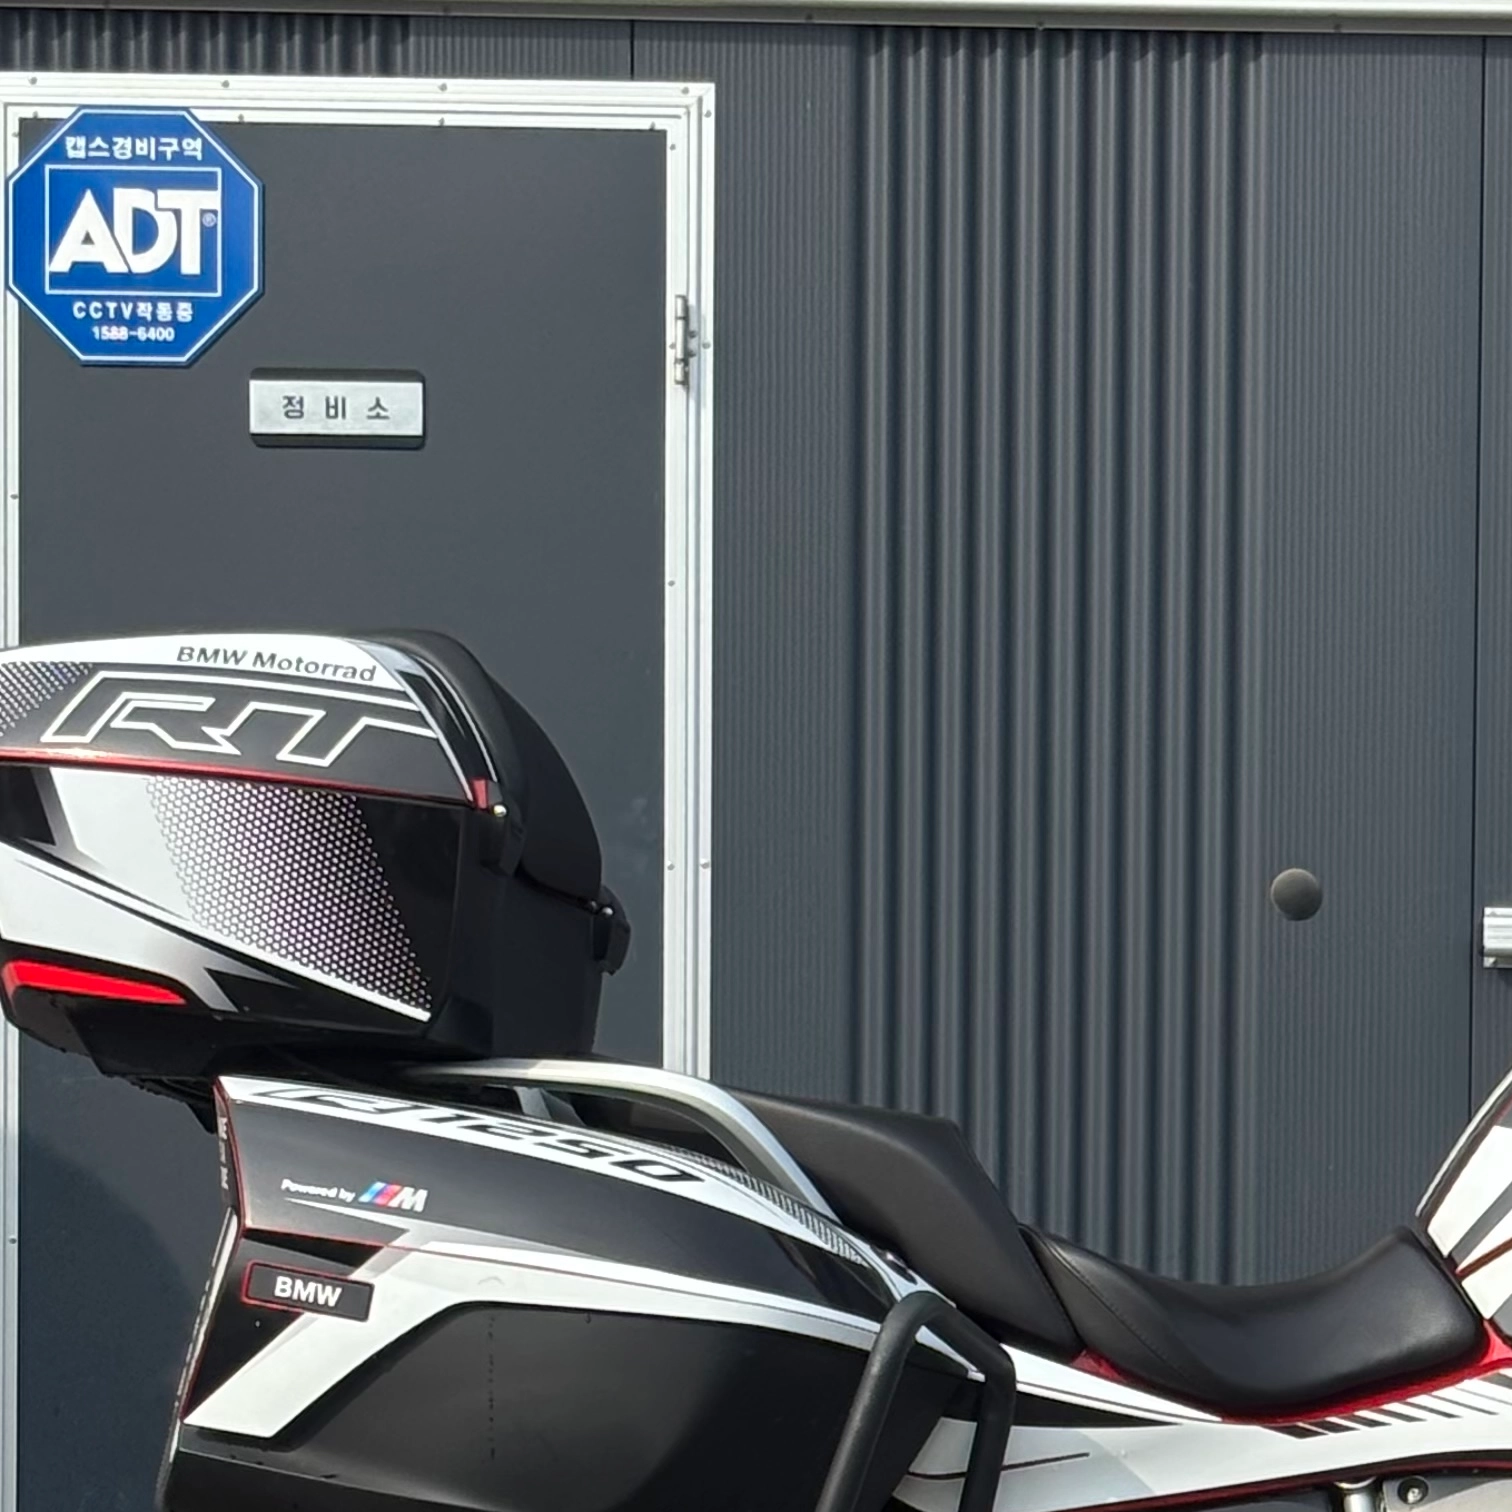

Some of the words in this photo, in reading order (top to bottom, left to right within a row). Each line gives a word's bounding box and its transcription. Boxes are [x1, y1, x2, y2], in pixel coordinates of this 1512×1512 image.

[65, 136, 204, 161] 캡스경비구역
[48, 188, 220, 275] ADT
[93, 326, 175, 342] 1588-6400
[177, 646, 249, 667] BMW
[253, 652, 376, 683] Motorrad
[281, 1178, 338, 1201] Powered
[339, 1187, 356, 1203] by
[273, 1275, 342, 1308] BMW
